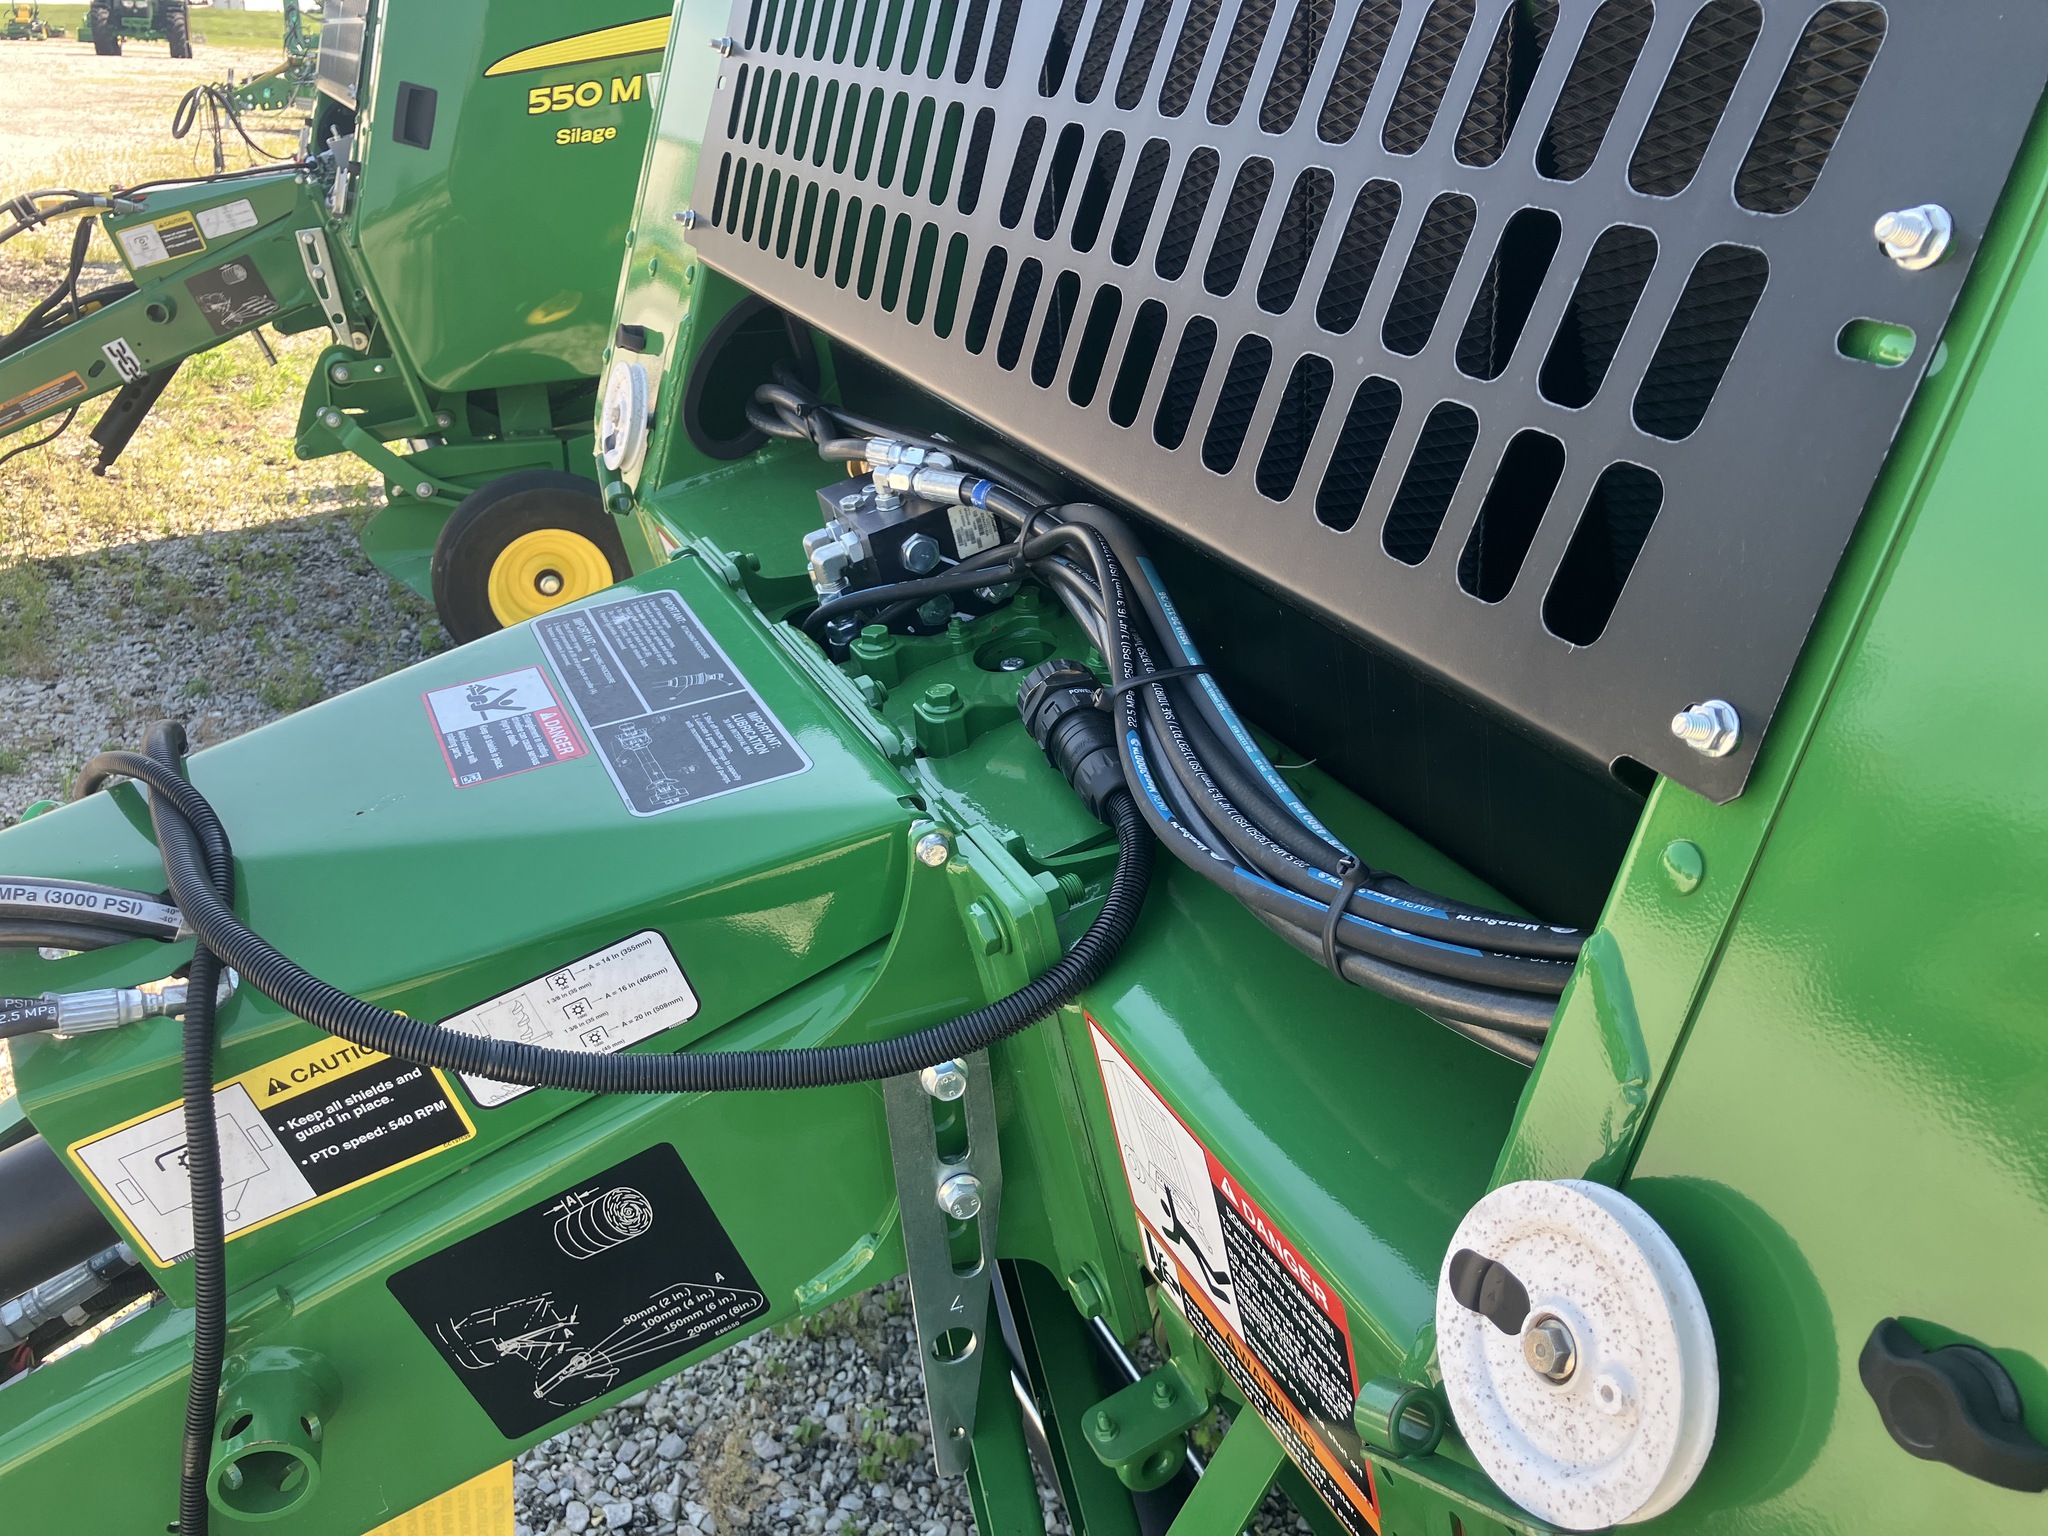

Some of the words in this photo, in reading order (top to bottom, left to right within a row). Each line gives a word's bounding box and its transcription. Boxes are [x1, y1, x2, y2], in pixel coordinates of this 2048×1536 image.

[528, 80, 603, 115] 550
[610, 74, 643, 104] M
[556, 126, 616, 145] Silage
[1108, 563, 1118, 577] ISO
[1118, 619, 1130, 639] 1/4"
[1175, 626, 1191, 646] MSHA
[1120, 641, 1132, 661] PSI)
[1125, 690, 1135, 708] MPa
[511, 716, 525, 732] driveline
[1126, 707, 1137, 725] 22.5
[446, 732, 458, 748] rotating
[457, 729, 468, 741] Avoid
[498, 719, 511, 730] injury
[506, 734, 520, 746] death.
[518, 731, 527, 739] can
[521, 713, 541, 738] Entanglement
[535, 741, 550, 758] rotating
[543, 719, 575, 755] DANGER
[730, 713, 770, 754] LUBRICATION
[746, 710, 782, 749] IMPORTANT:
[461, 740, 474, 755] contact
[478, 724, 489, 735] Keep
[484, 738, 498, 753] shields
[491, 756, 504, 770] place.
[522, 739, 533, 750] cause
[730, 728, 748, 746] INTERVAL
[742, 745, 754, 755] MAX
[449, 747, 462, 759] parts.
[467, 754, 478, 764] with
[527, 750, 540, 765] serious
[1288, 801, 1308, 814] psi
[1302, 814, 1327, 835] 4800
[44, 889, 98, 908] (3000
[103, 897, 143, 916] PSI)
[601, 956, 611, 964] 14
[620, 937, 652, 957] (355mm)
[567, 987, 578, 996] (35
[578, 981, 592, 991] mm)
[618, 984, 628, 993] 16
[636, 966, 668, 986] (406mm)
[24, 1005, 56, 1017] MPa
[585, 1016, 595, 1025] (35
[595, 1010, 609, 1020] mm)
[633, 1013, 644, 1021] 20
[652, 995, 684, 1014] (508mm)
[286, 1110, 324, 1130] Keep
[325, 1099, 344, 1114] all
[344, 1080, 394, 1106] shields
[395, 1066, 423, 1085] and
[295, 1116, 336, 1142] guard
[335, 1112, 352, 1123] in
[352, 1096, 395, 1118] place.
[309, 1144, 340, 1164] PTO
[342, 1126, 388, 1150] speed:
[388, 1114, 414, 1131] 540
[414, 1099, 448, 1120] RPM
[565, 1195, 577, 1207] A
[1240, 1198, 1329, 1312] DANGER
[714, 1271, 725, 1283] A
[1220, 1213, 1232, 1232] To
[1233, 1230, 1257, 1262] avoid
[1258, 1258, 1285, 1296] injury
[1287, 1295, 1298, 1310] or
[1299, 1310, 1327, 1345] death
[1329, 1342, 1342, 1363] by
[1254, 1239, 1282, 1280] TAKE
[1282, 1272, 1336, 1342] CHANCES!
[622, 1304, 658, 1326] 50mm
[658, 1297, 672, 1309] (2
[671, 1287, 691, 1301] in.)
[641, 1306, 682, 1330] 100mm
[682, 1298, 695, 1310] (4
[695, 1287, 715, 1302] in.)
[663, 1309, 704, 1334] 150mm
[705, 1302, 717, 1314] (6
[717, 1292, 737, 1306] in.)
[686, 1313, 728, 1337] 200mm
[728, 1297, 757, 1317] (8in.)
[563, 1327, 575, 1339] A
[1237, 1345, 1316, 1453] WARNING
